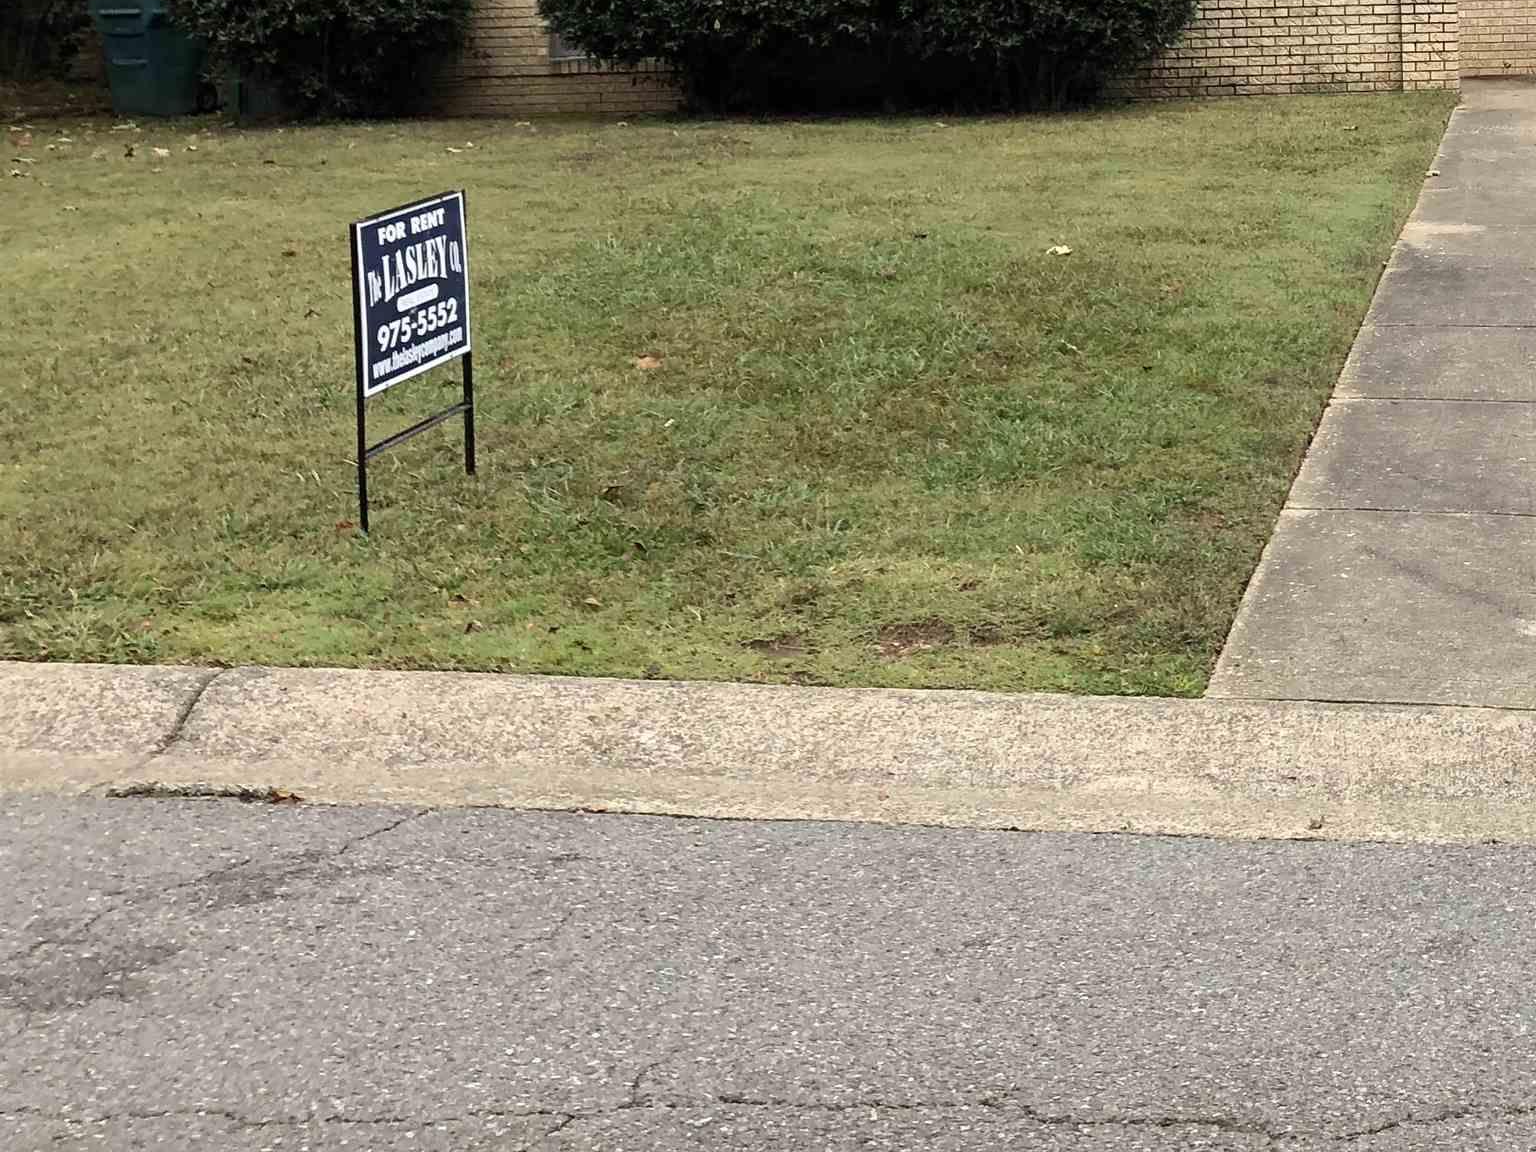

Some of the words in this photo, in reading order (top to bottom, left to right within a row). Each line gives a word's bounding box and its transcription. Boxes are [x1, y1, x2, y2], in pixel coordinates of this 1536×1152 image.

[376, 222, 406, 245] FOR
[411, 208, 445, 234] RENT
[382, 235, 448, 302] LASLEY
[377, 298, 458, 352] 975-5552
